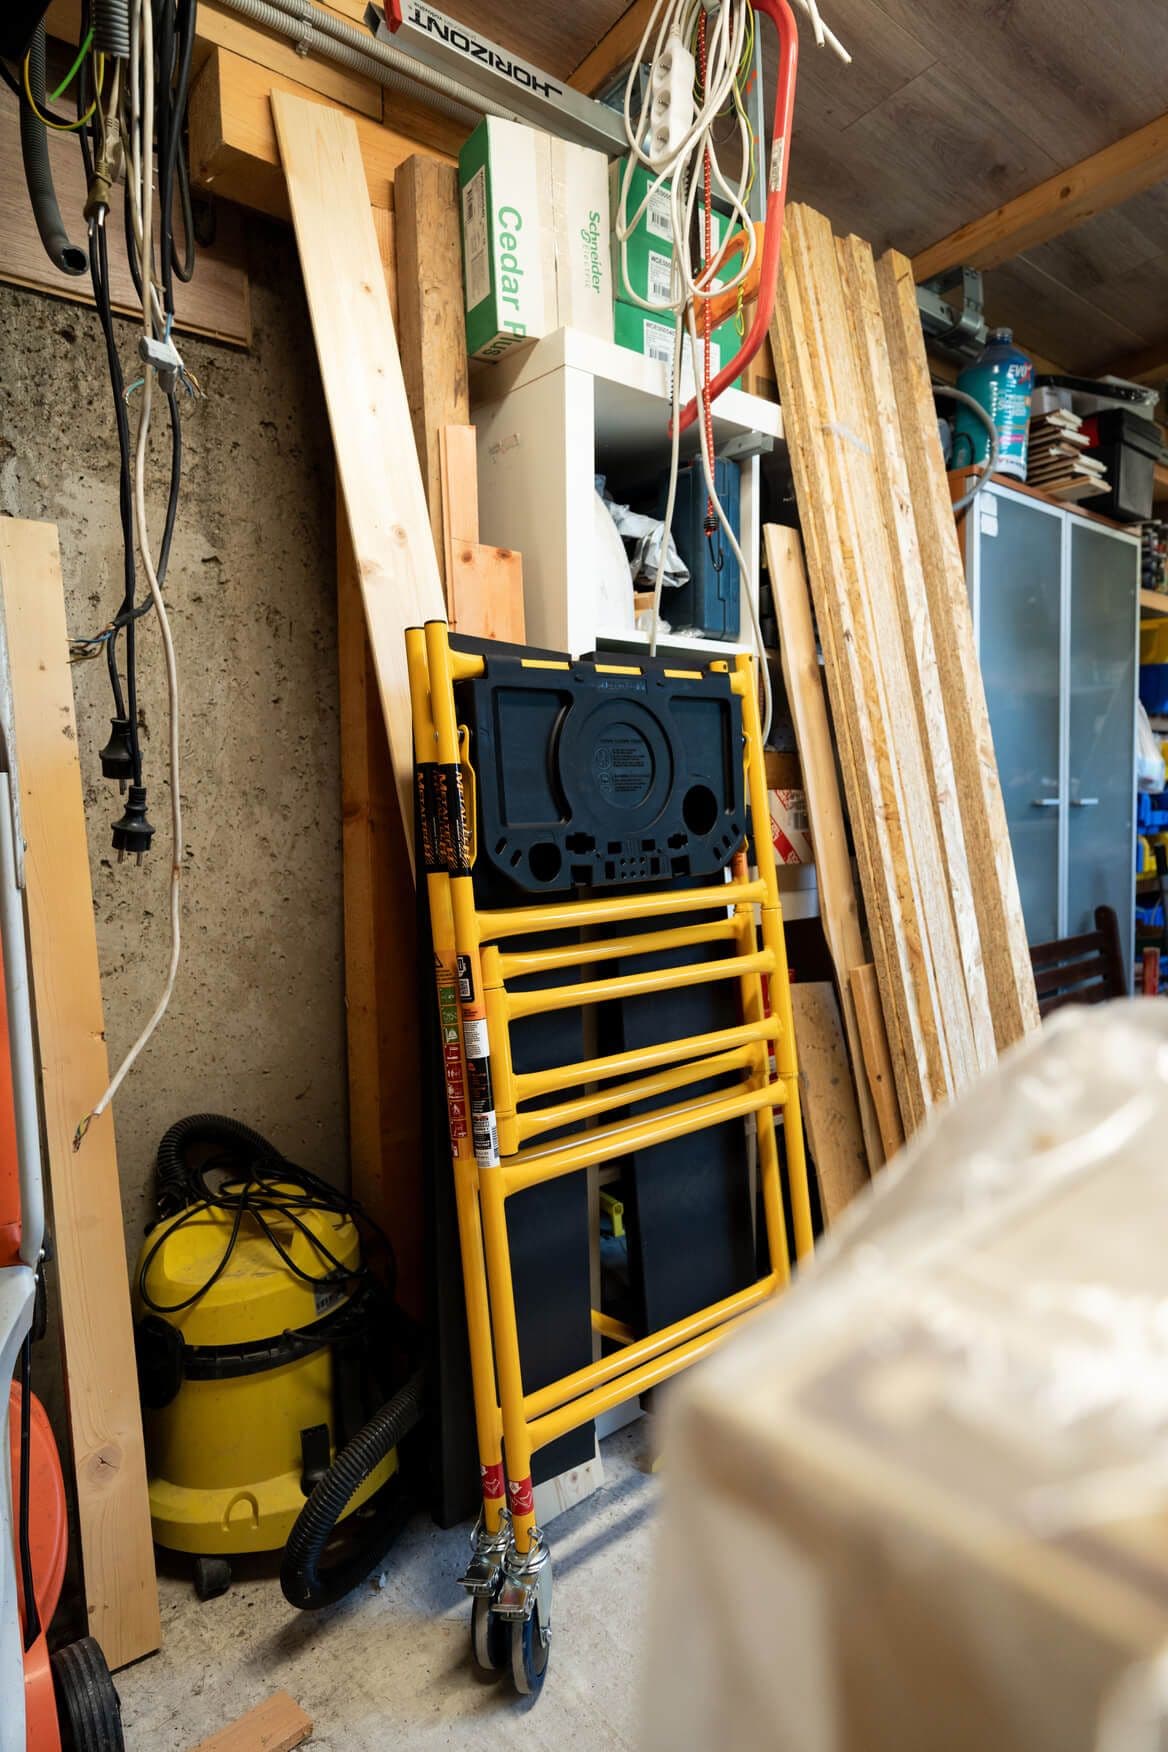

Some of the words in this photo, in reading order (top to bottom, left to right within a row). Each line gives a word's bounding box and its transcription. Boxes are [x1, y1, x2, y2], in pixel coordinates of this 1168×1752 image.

[408, 9, 563, 98] HORIZONT
[498, 205, 525, 311] Cedar
[589, 211, 603, 294] Schneider
[481, 320, 527, 357] Plus
